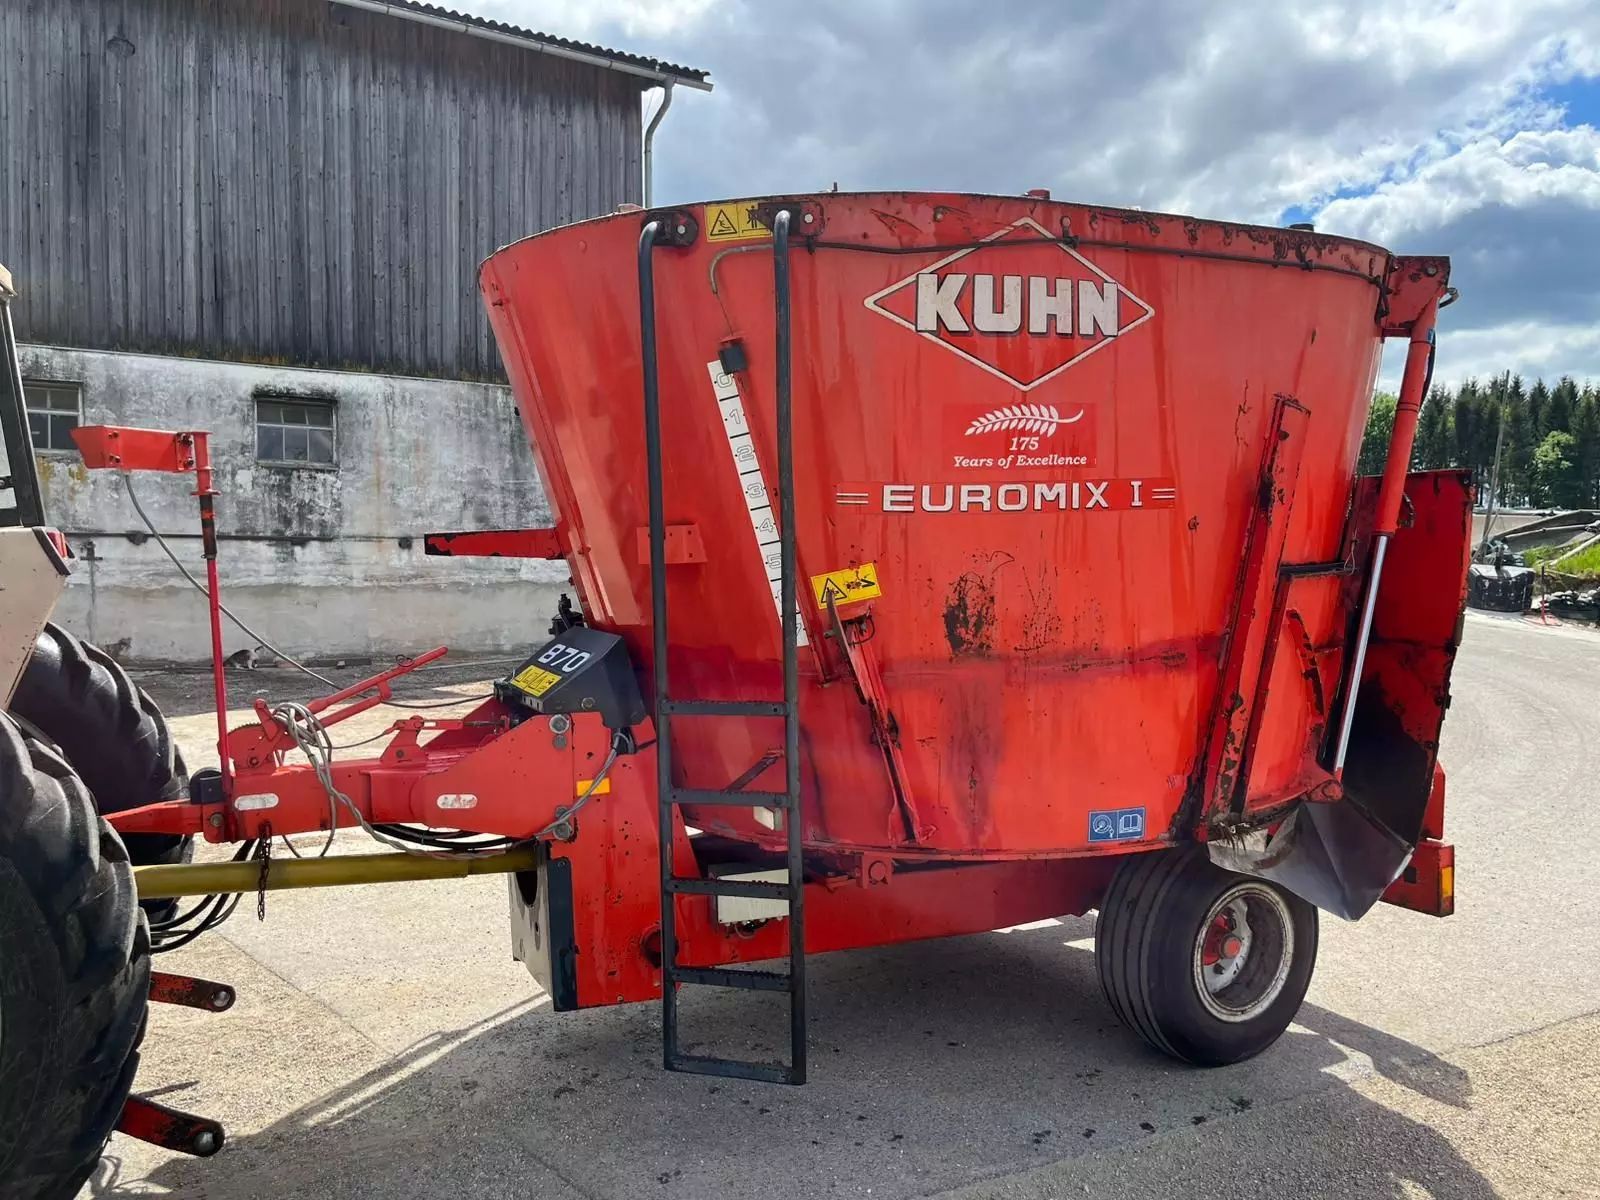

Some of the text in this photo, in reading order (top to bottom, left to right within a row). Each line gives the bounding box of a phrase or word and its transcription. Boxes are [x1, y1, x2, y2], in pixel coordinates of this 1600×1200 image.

[914, 272, 1119, 337] KUHN
[729, 408, 741, 424] 1
[1009, 436, 1040, 451] 175
[737, 444, 755, 462] 2
[953, 454, 1087, 469] Years of Excellence
[747, 482, 764, 498] 3
[882, 480, 1143, 511] EUROMIX I
[759, 517, 774, 533] 4
[766, 553, 782, 570] 5
[538, 643, 591, 673] 870
